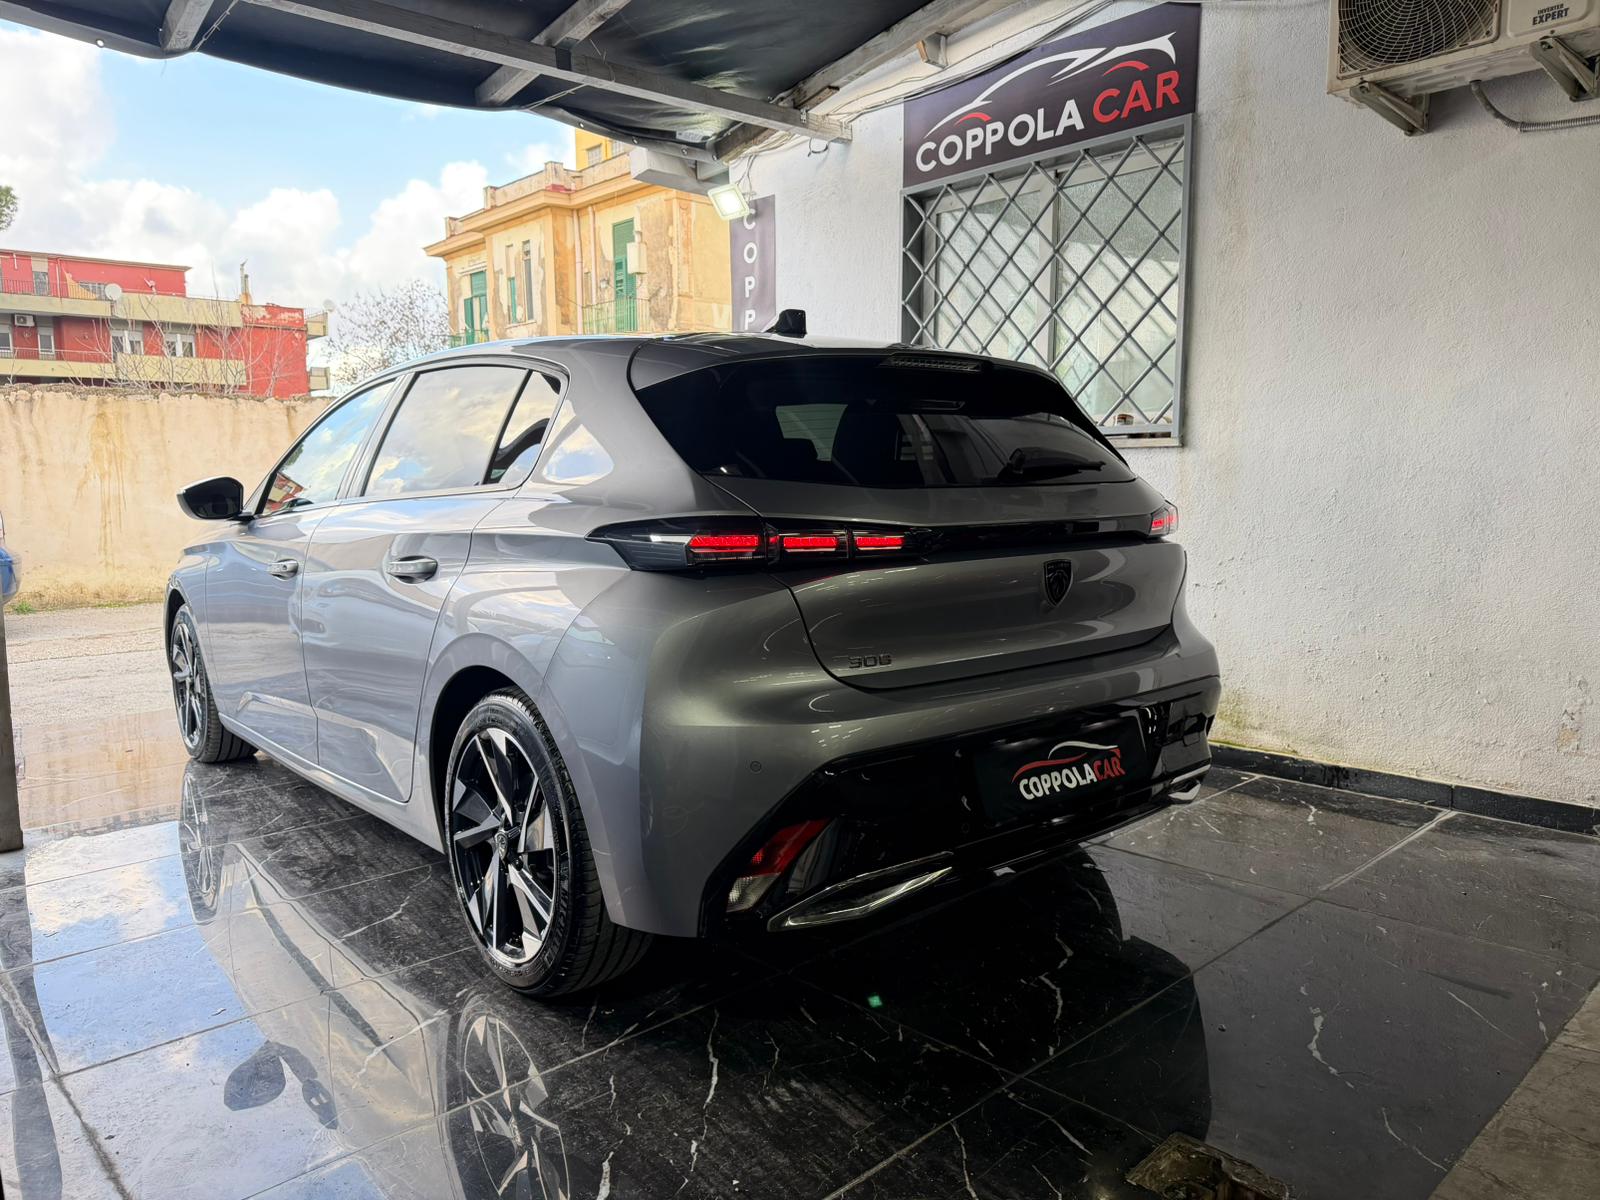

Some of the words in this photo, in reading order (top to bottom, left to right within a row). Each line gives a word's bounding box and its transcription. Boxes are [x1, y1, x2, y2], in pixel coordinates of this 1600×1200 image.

[1532, 8, 1569, 25] EXPERT
[916, 99, 1084, 172] COPPOLA
[1092, 70, 1180, 124] CAR
